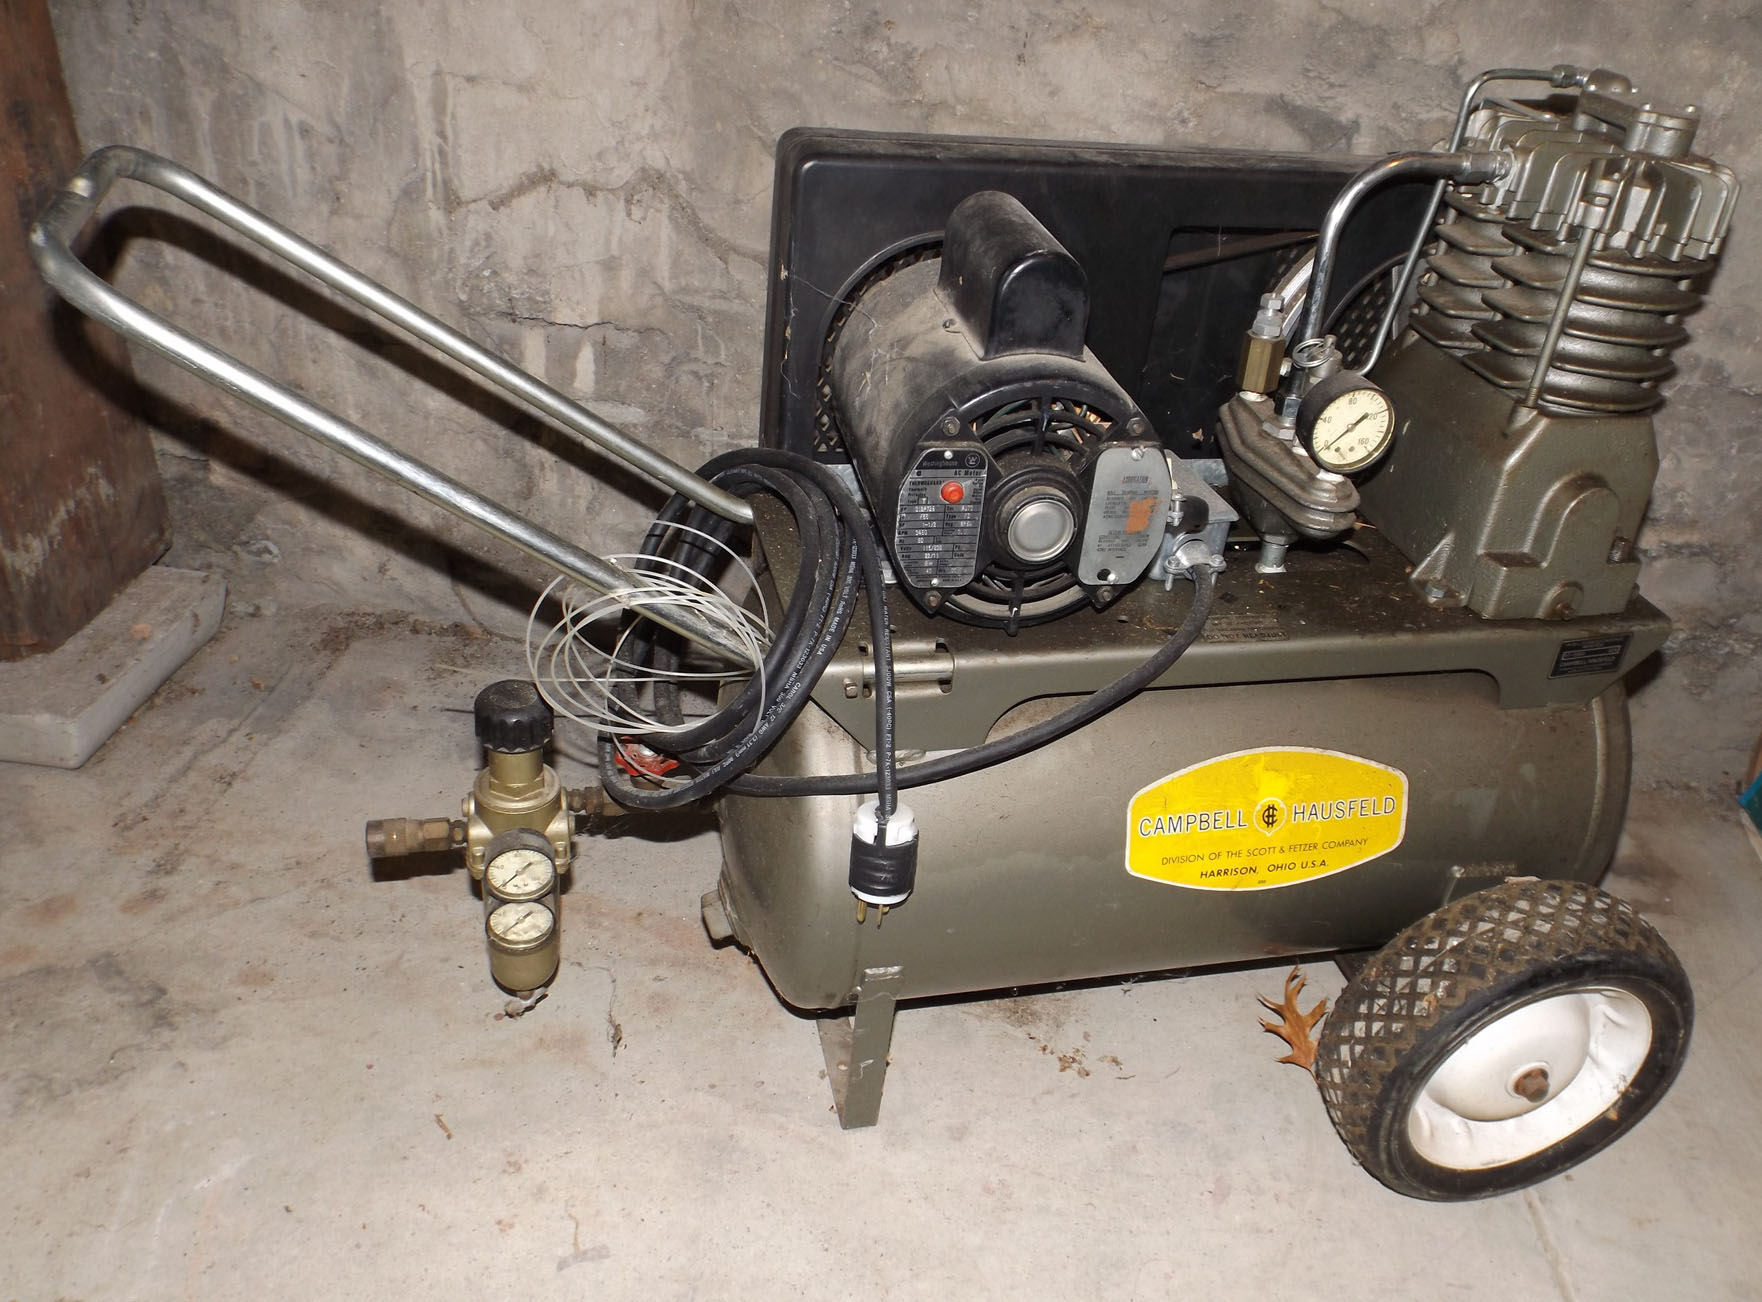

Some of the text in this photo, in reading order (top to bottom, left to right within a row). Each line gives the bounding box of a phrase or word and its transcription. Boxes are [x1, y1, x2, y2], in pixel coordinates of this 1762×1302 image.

[828, 616, 840, 632] MADE
[825, 634, 832, 642] IN
[816, 644, 827, 656] USA
[784, 672, 798, 690] MSHA
[786, 682, 802, 700] CAROL
[759, 724, 770, 735] AWG
[1138, 809, 1248, 837] CAMPBELL
[1292, 796, 1396, 824] HAUSFELD
[1161, 838, 1368, 866] DIVISION OF THE SCOTT & FETZER COMPANY
[1200, 858, 1330, 880] HARRISON, OHIO U.S.A.
